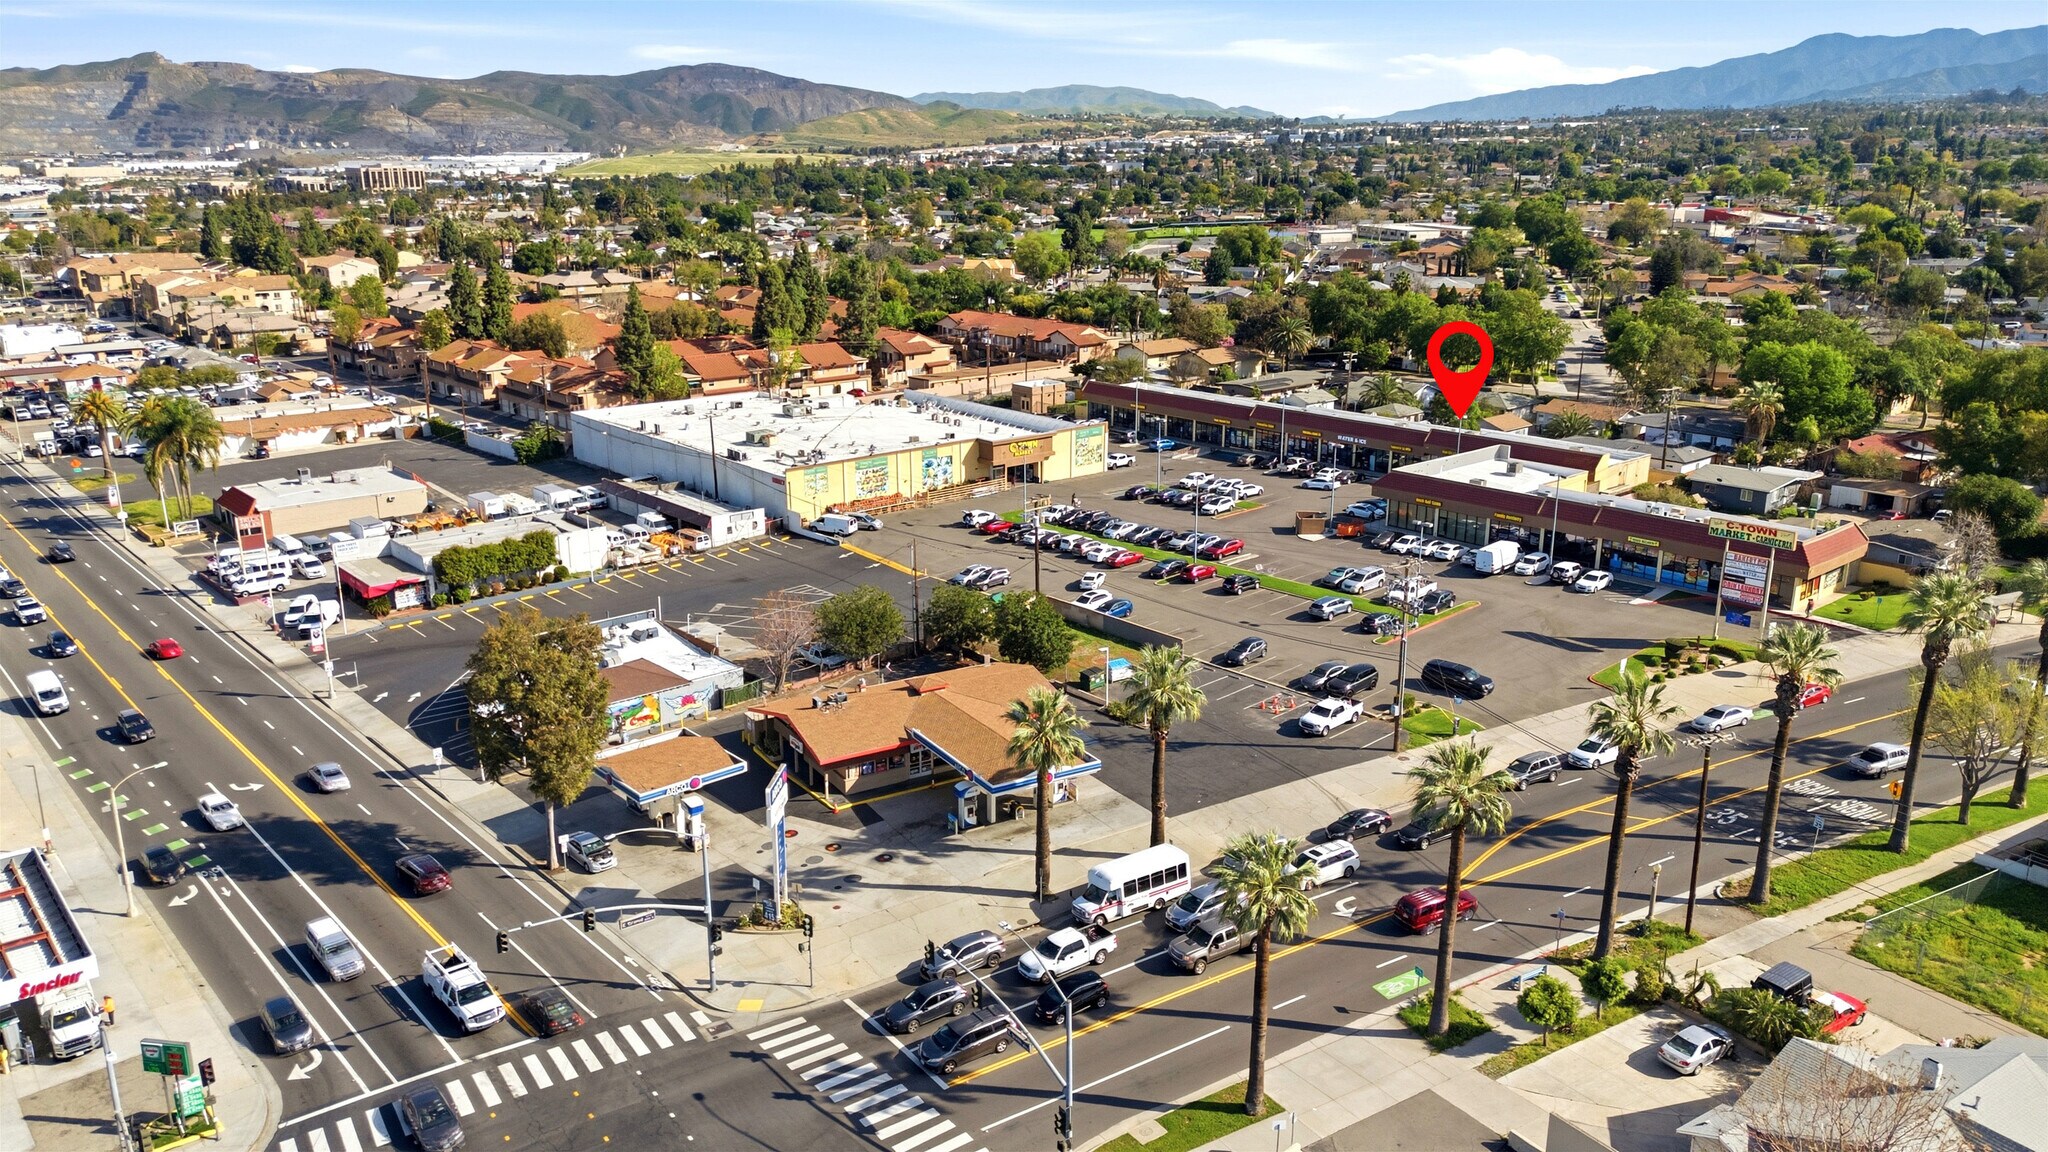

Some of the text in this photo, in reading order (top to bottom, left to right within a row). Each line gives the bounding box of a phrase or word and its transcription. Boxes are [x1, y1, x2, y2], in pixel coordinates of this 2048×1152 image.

[1709, 527, 1752, 541] MARKET
[1755, 535, 1793, 549] CARNICERIA
[1726, 521, 1777, 537] C-TOWN
[18, 971, 83, 999] Sinclair
